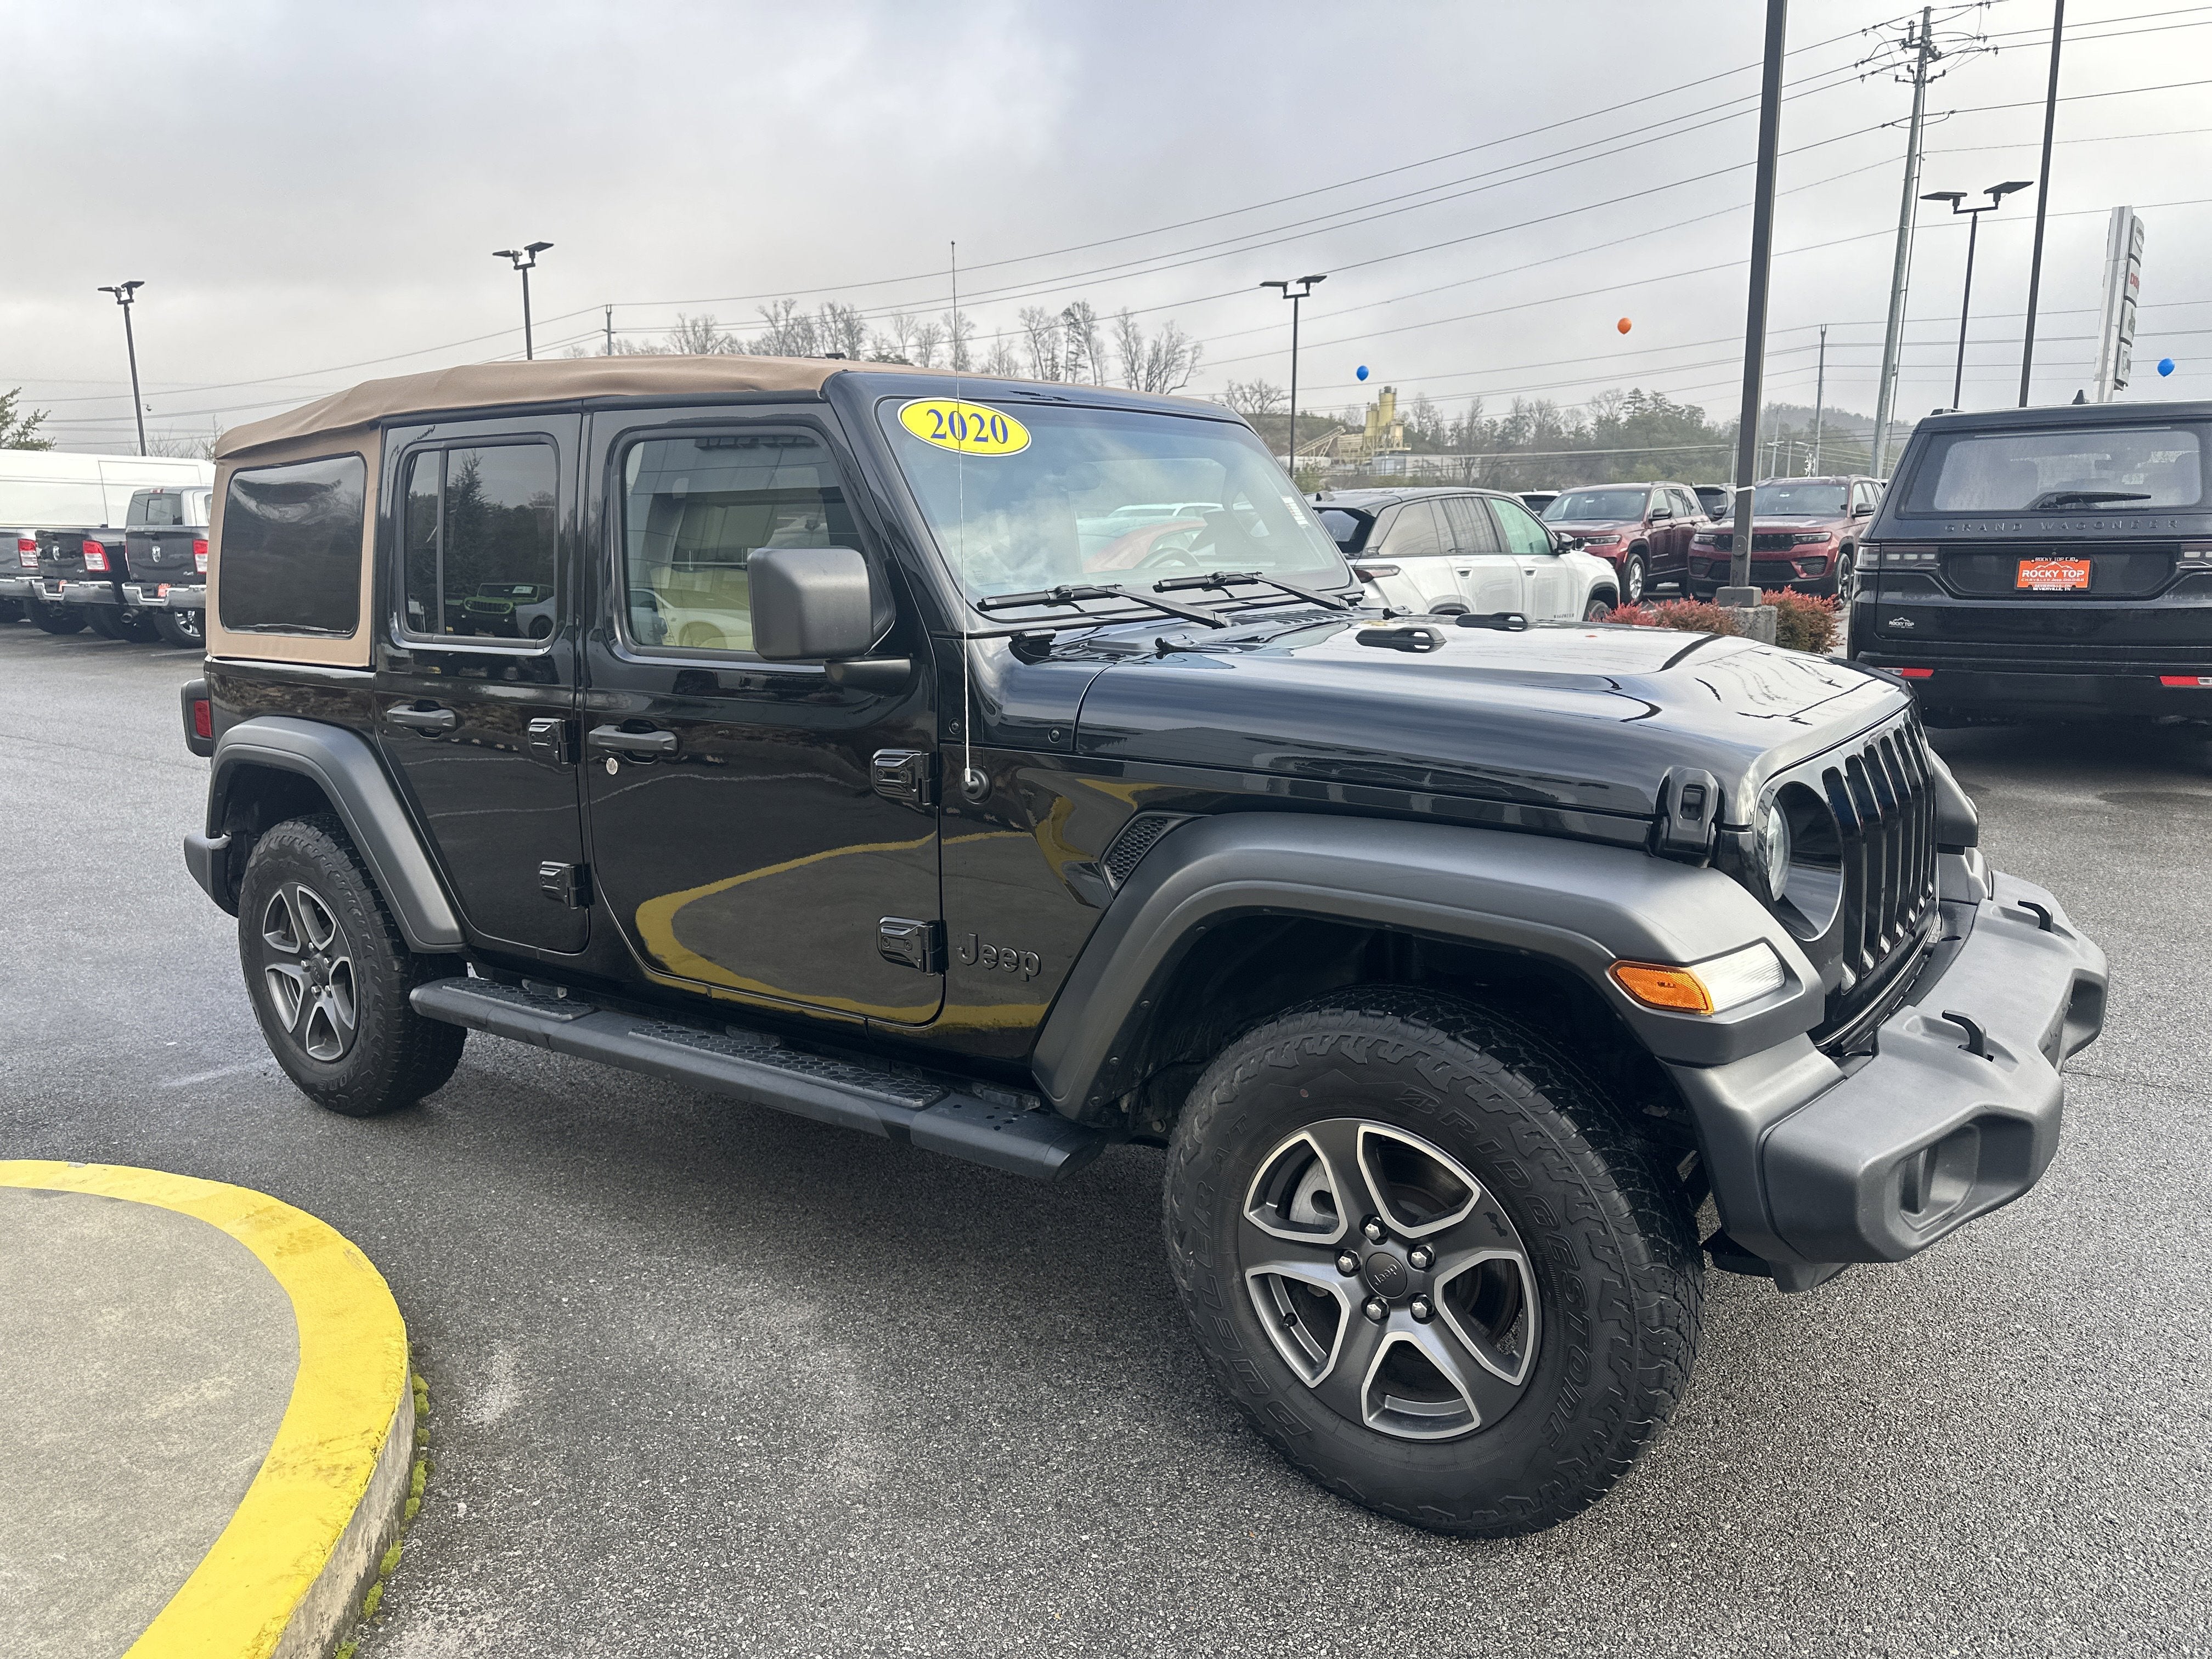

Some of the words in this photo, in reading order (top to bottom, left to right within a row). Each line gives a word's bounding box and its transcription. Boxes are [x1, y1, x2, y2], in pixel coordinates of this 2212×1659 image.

[926, 408, 1008, 444] 2020
[1944, 522, 2023, 532] GRAND
[2040, 519, 2178, 531] WAGONEER
[2022, 569, 2059, 578] ROCKY
[2061, 569, 2085, 578] TOP
[956, 933, 1042, 982] Jeep
[1211, 1112, 1248, 1176] A/T
[1374, 1263, 1397, 1285] Jeep
[1395, 1086, 1594, 1451] BRIDGESTONE
[1192, 1180, 1312, 1436] DUELER
